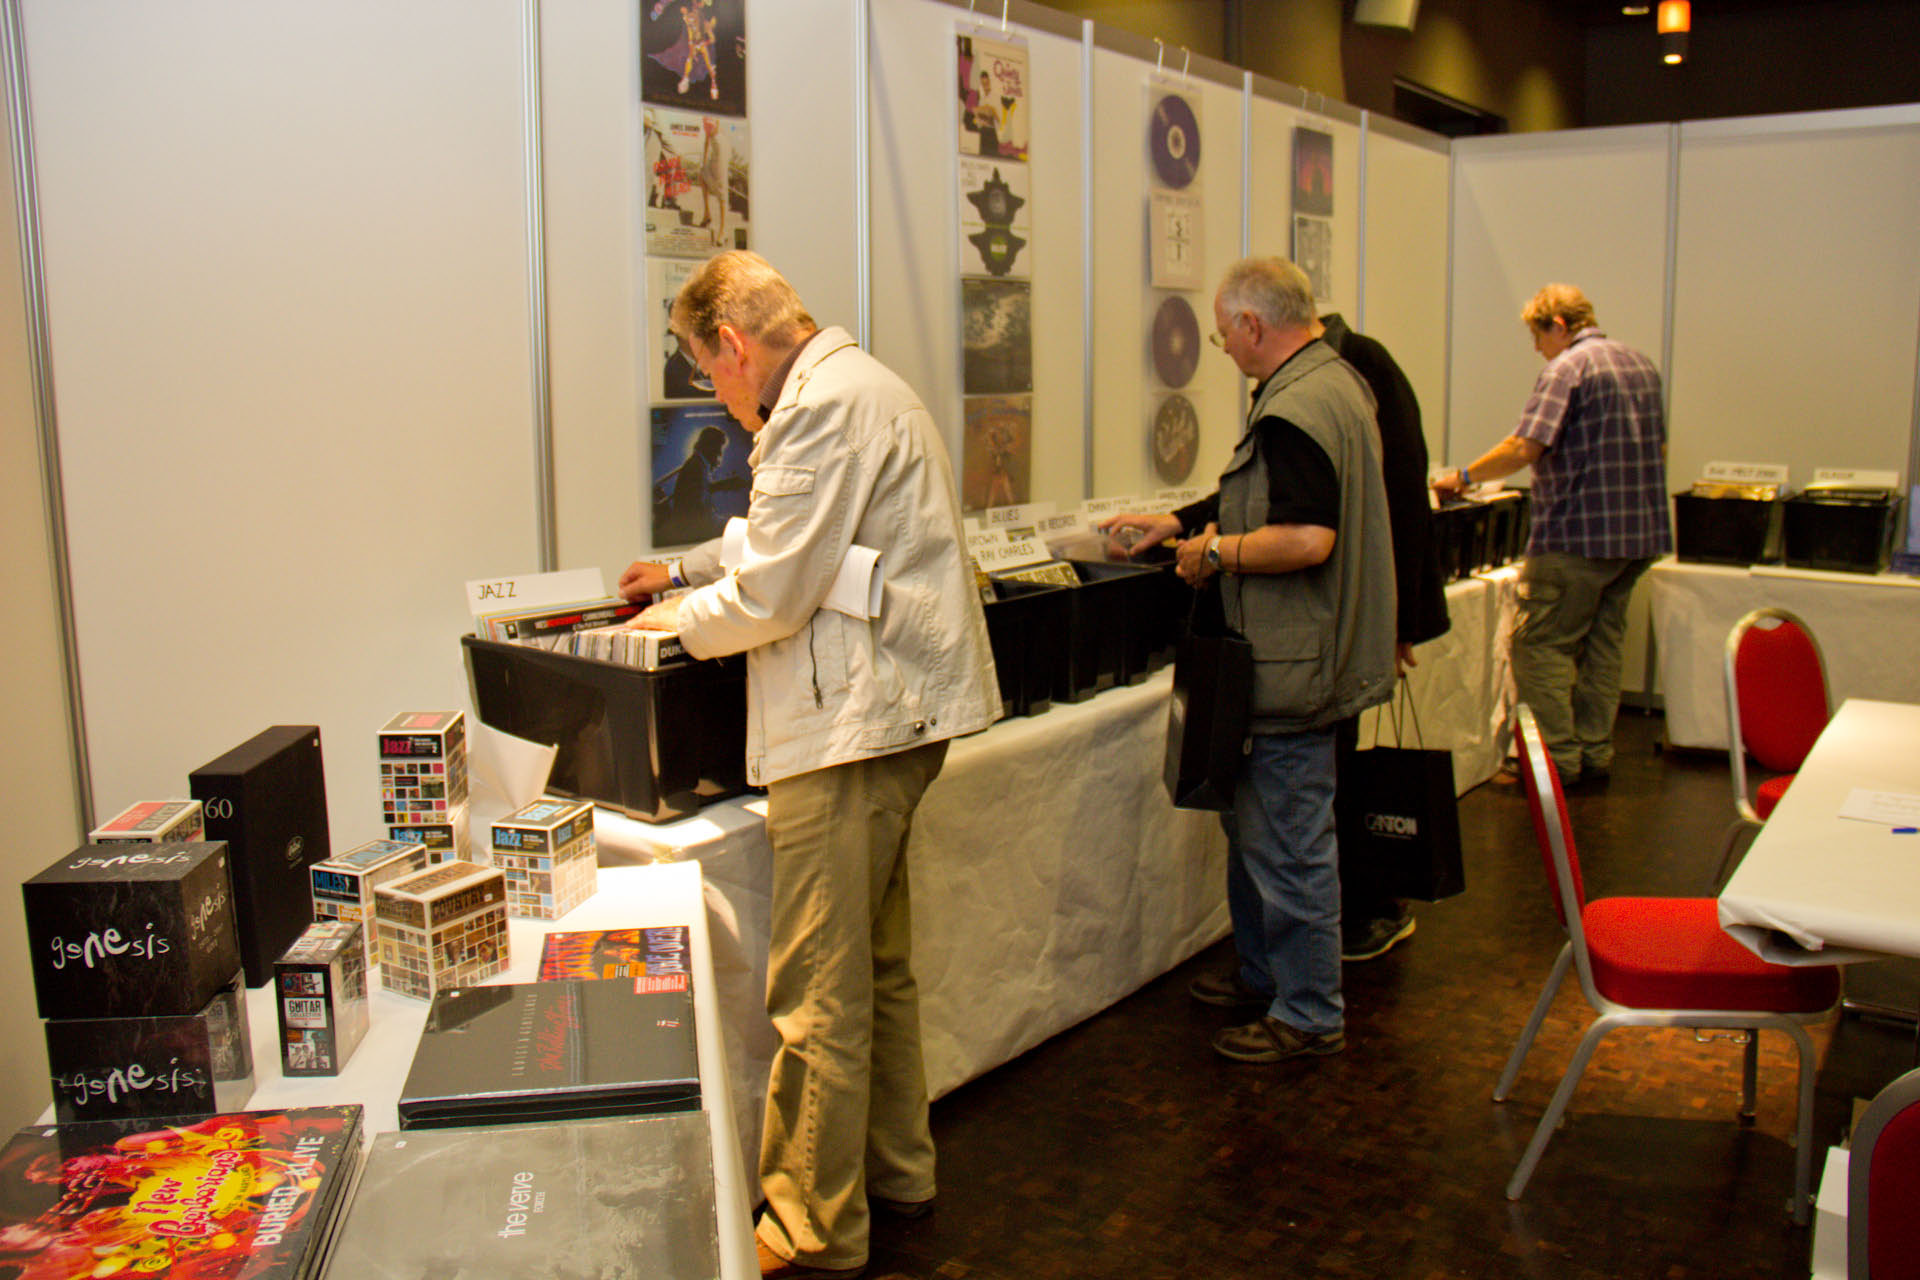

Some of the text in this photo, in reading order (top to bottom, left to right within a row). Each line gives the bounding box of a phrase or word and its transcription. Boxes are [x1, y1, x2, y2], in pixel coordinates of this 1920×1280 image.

[478, 581, 518, 600] JAZZ
[659, 644, 684, 659] DUK
[383, 737, 412, 754] Jazz
[204, 796, 233, 819] 60
[495, 828, 523, 847] Jazz
[314, 870, 346, 891] MILES
[50, 922, 170, 970] genesis
[288, 1000, 321, 1014] GUITAR
[72, 1056, 197, 1105] genesis
[251, 1135, 325, 1247] BURIED ALIVE
[497, 1171, 534, 1239] the verve
